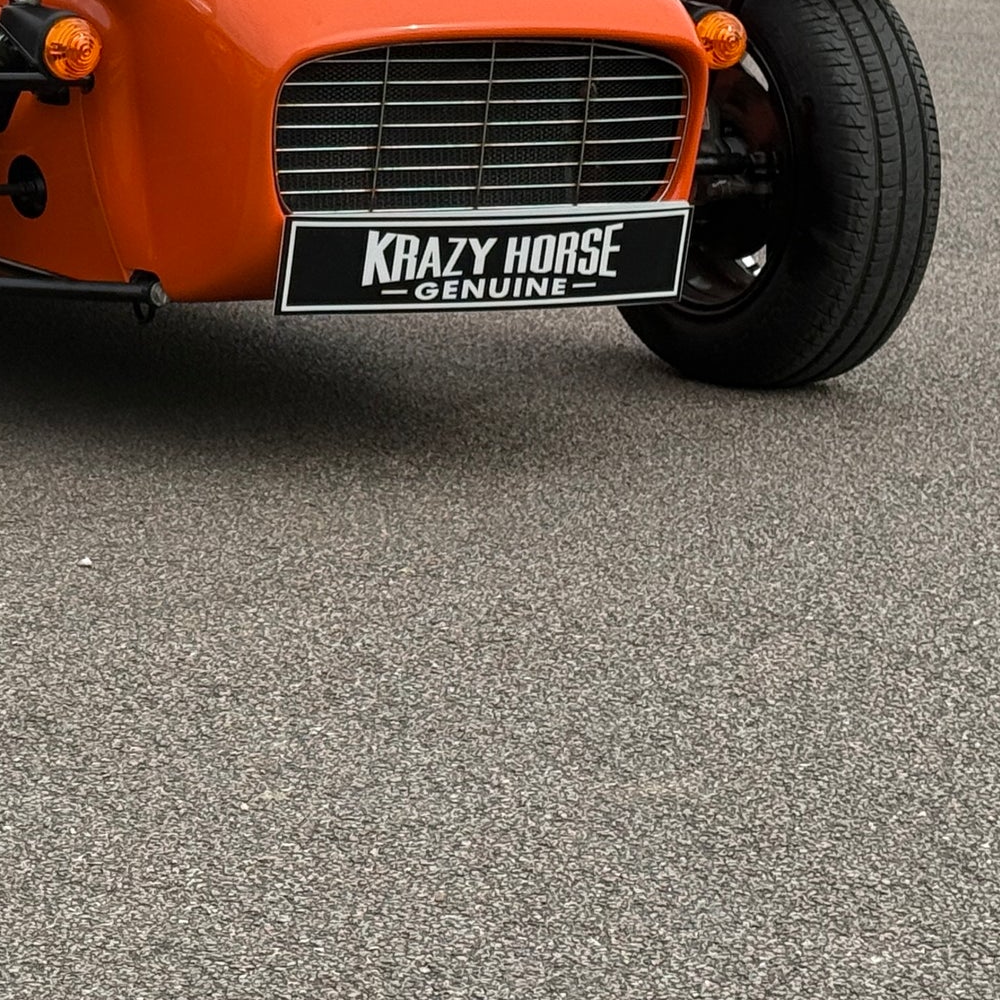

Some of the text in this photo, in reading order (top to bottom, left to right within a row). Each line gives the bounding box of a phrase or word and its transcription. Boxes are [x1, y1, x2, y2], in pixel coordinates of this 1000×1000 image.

[361, 222, 624, 287] KRAZY HORSE
[414, 277, 567, 301] GENUINE
